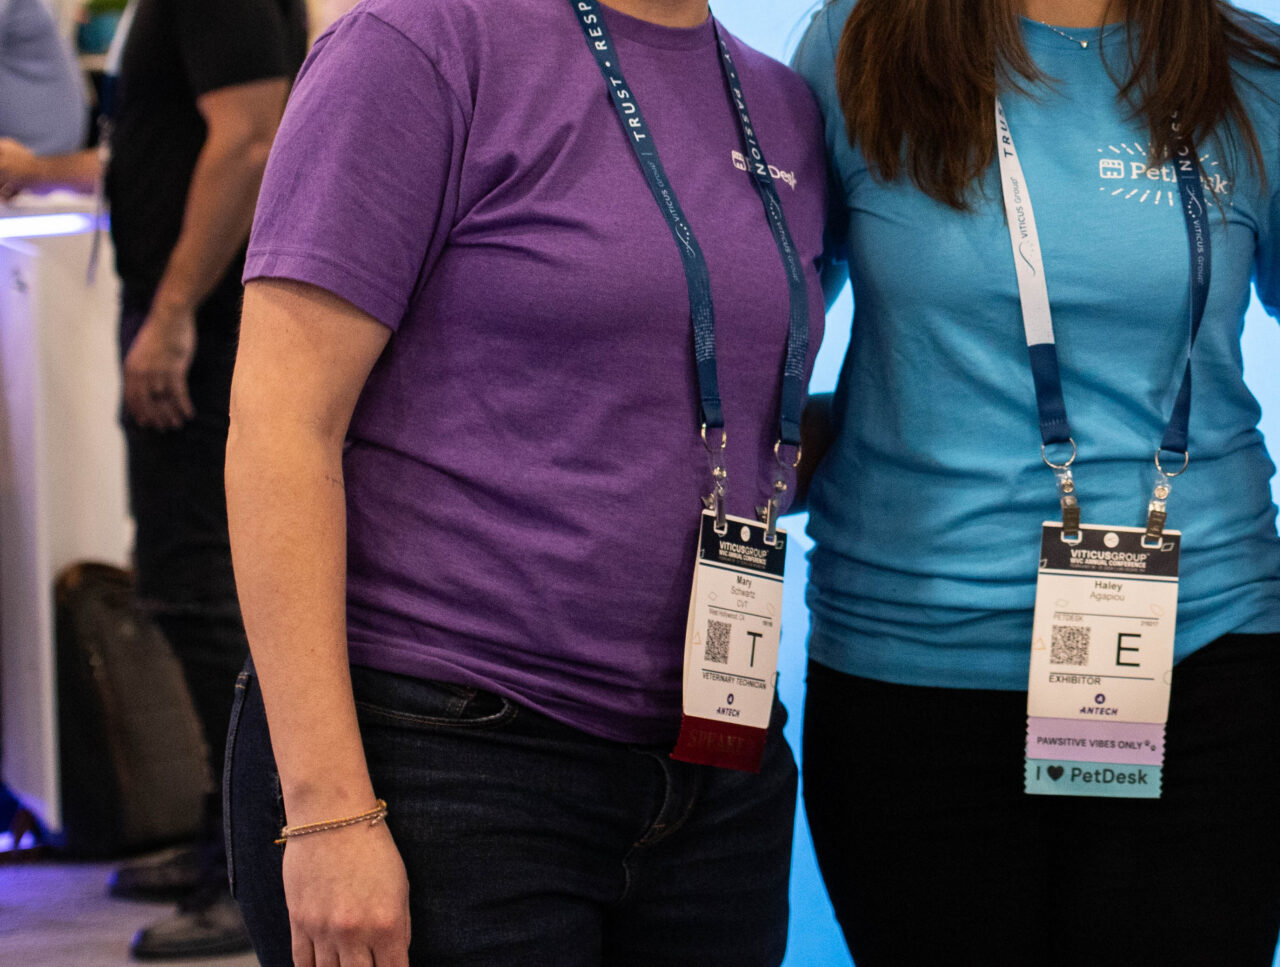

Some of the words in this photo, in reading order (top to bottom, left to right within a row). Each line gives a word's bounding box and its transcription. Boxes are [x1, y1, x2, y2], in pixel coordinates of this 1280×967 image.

[610, 76, 646, 142] TRUST
[733, 87, 767, 176] PASSION
[661, 189, 680, 222] VITICUS
[1016, 206, 1028, 239] VITICUS
[1193, 220, 1205, 253] VITICUS
[1070, 549, 1147, 562] VITICUSGROUP
[736, 575, 752, 588] Mary
[1094, 580, 1123, 592] Haley
[747, 631, 763, 667] T
[1116, 633, 1142, 667] E
[702, 672, 736, 684] VETERINARY
[736, 677, 767, 689] TECHNICIAN
[1048, 674, 1101, 685] EXHIBITOR
[717, 707, 740, 717] ANTECH
[1080, 706, 1118, 716] ANTECH
[1036, 736, 1086, 747] PAWSITIVE
[1089, 739, 1116, 749] VIBES
[1118, 741, 1143, 750] ONLY
[1036, 766, 1041, 781] I
[1070, 767, 1149, 785] PetDesk
